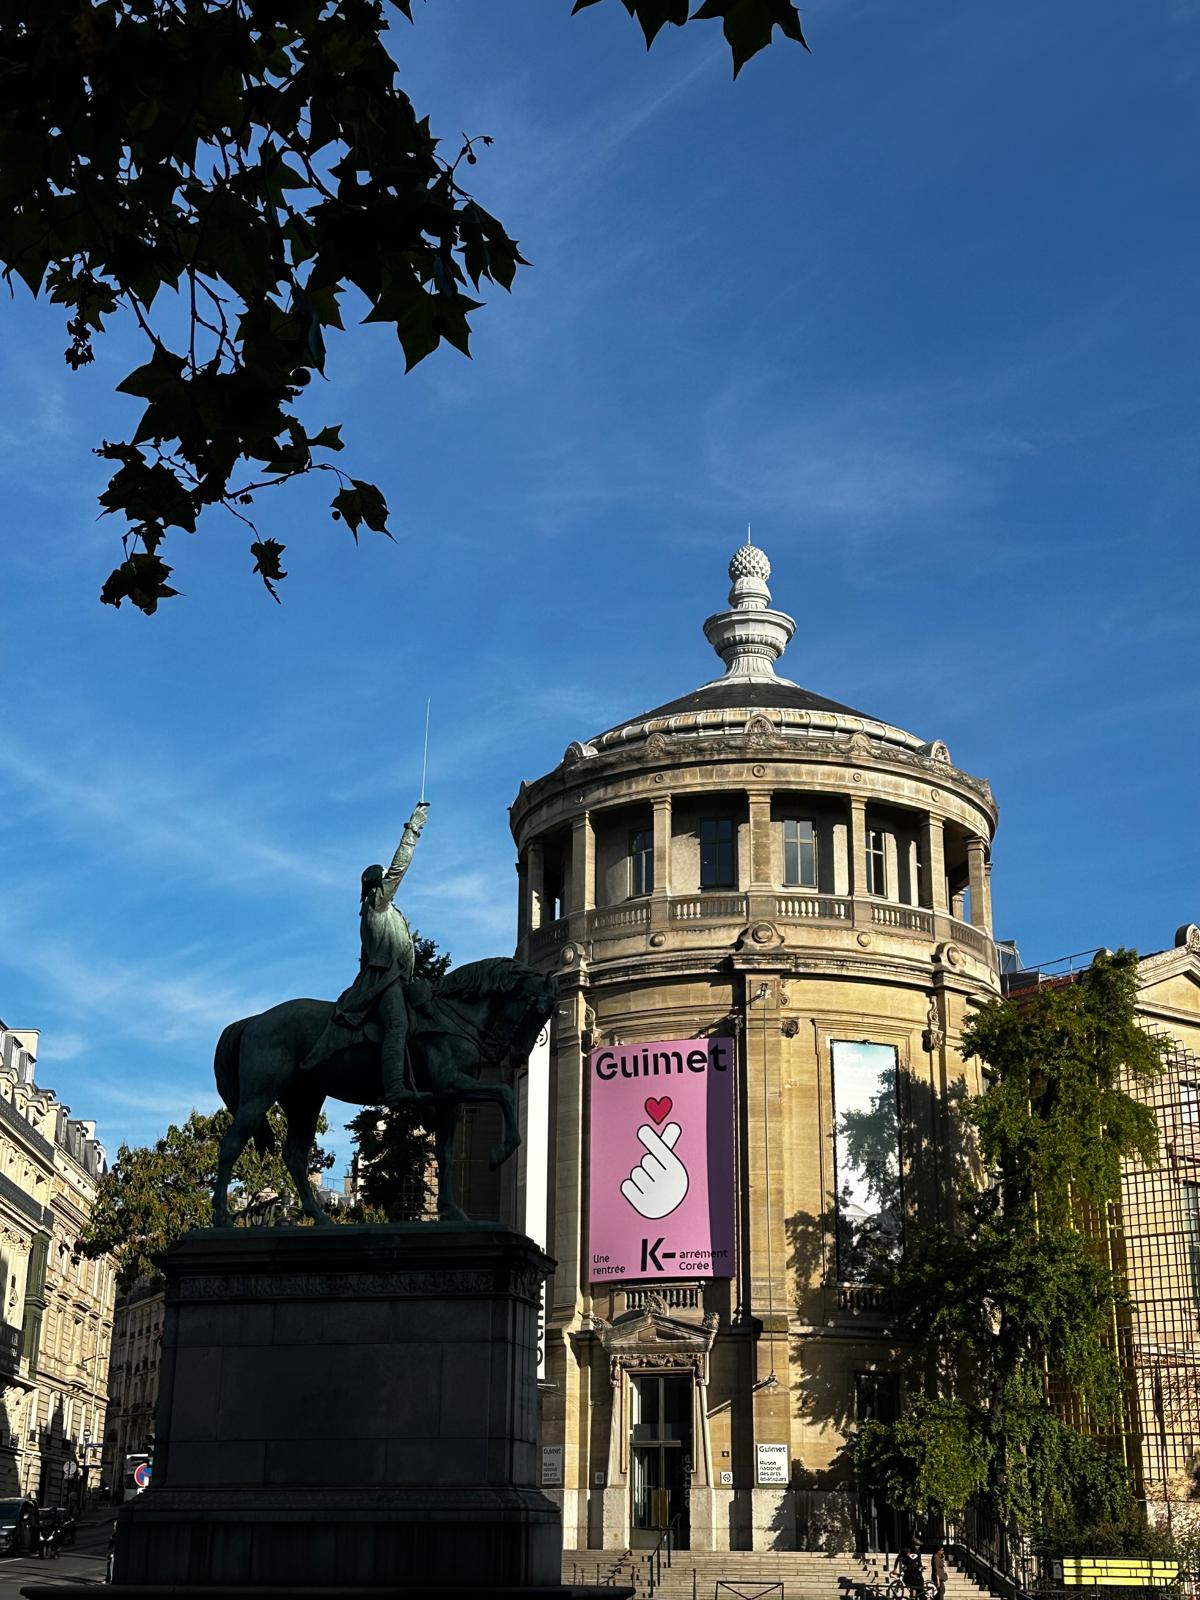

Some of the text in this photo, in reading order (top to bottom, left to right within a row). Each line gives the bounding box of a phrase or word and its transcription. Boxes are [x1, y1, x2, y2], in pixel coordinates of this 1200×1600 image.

[596, 1044, 727, 1080] Guimet
[593, 1254, 610, 1264] Une
[593, 1264, 626, 1275] rentrée
[679, 1261, 710, 1271] Corée
